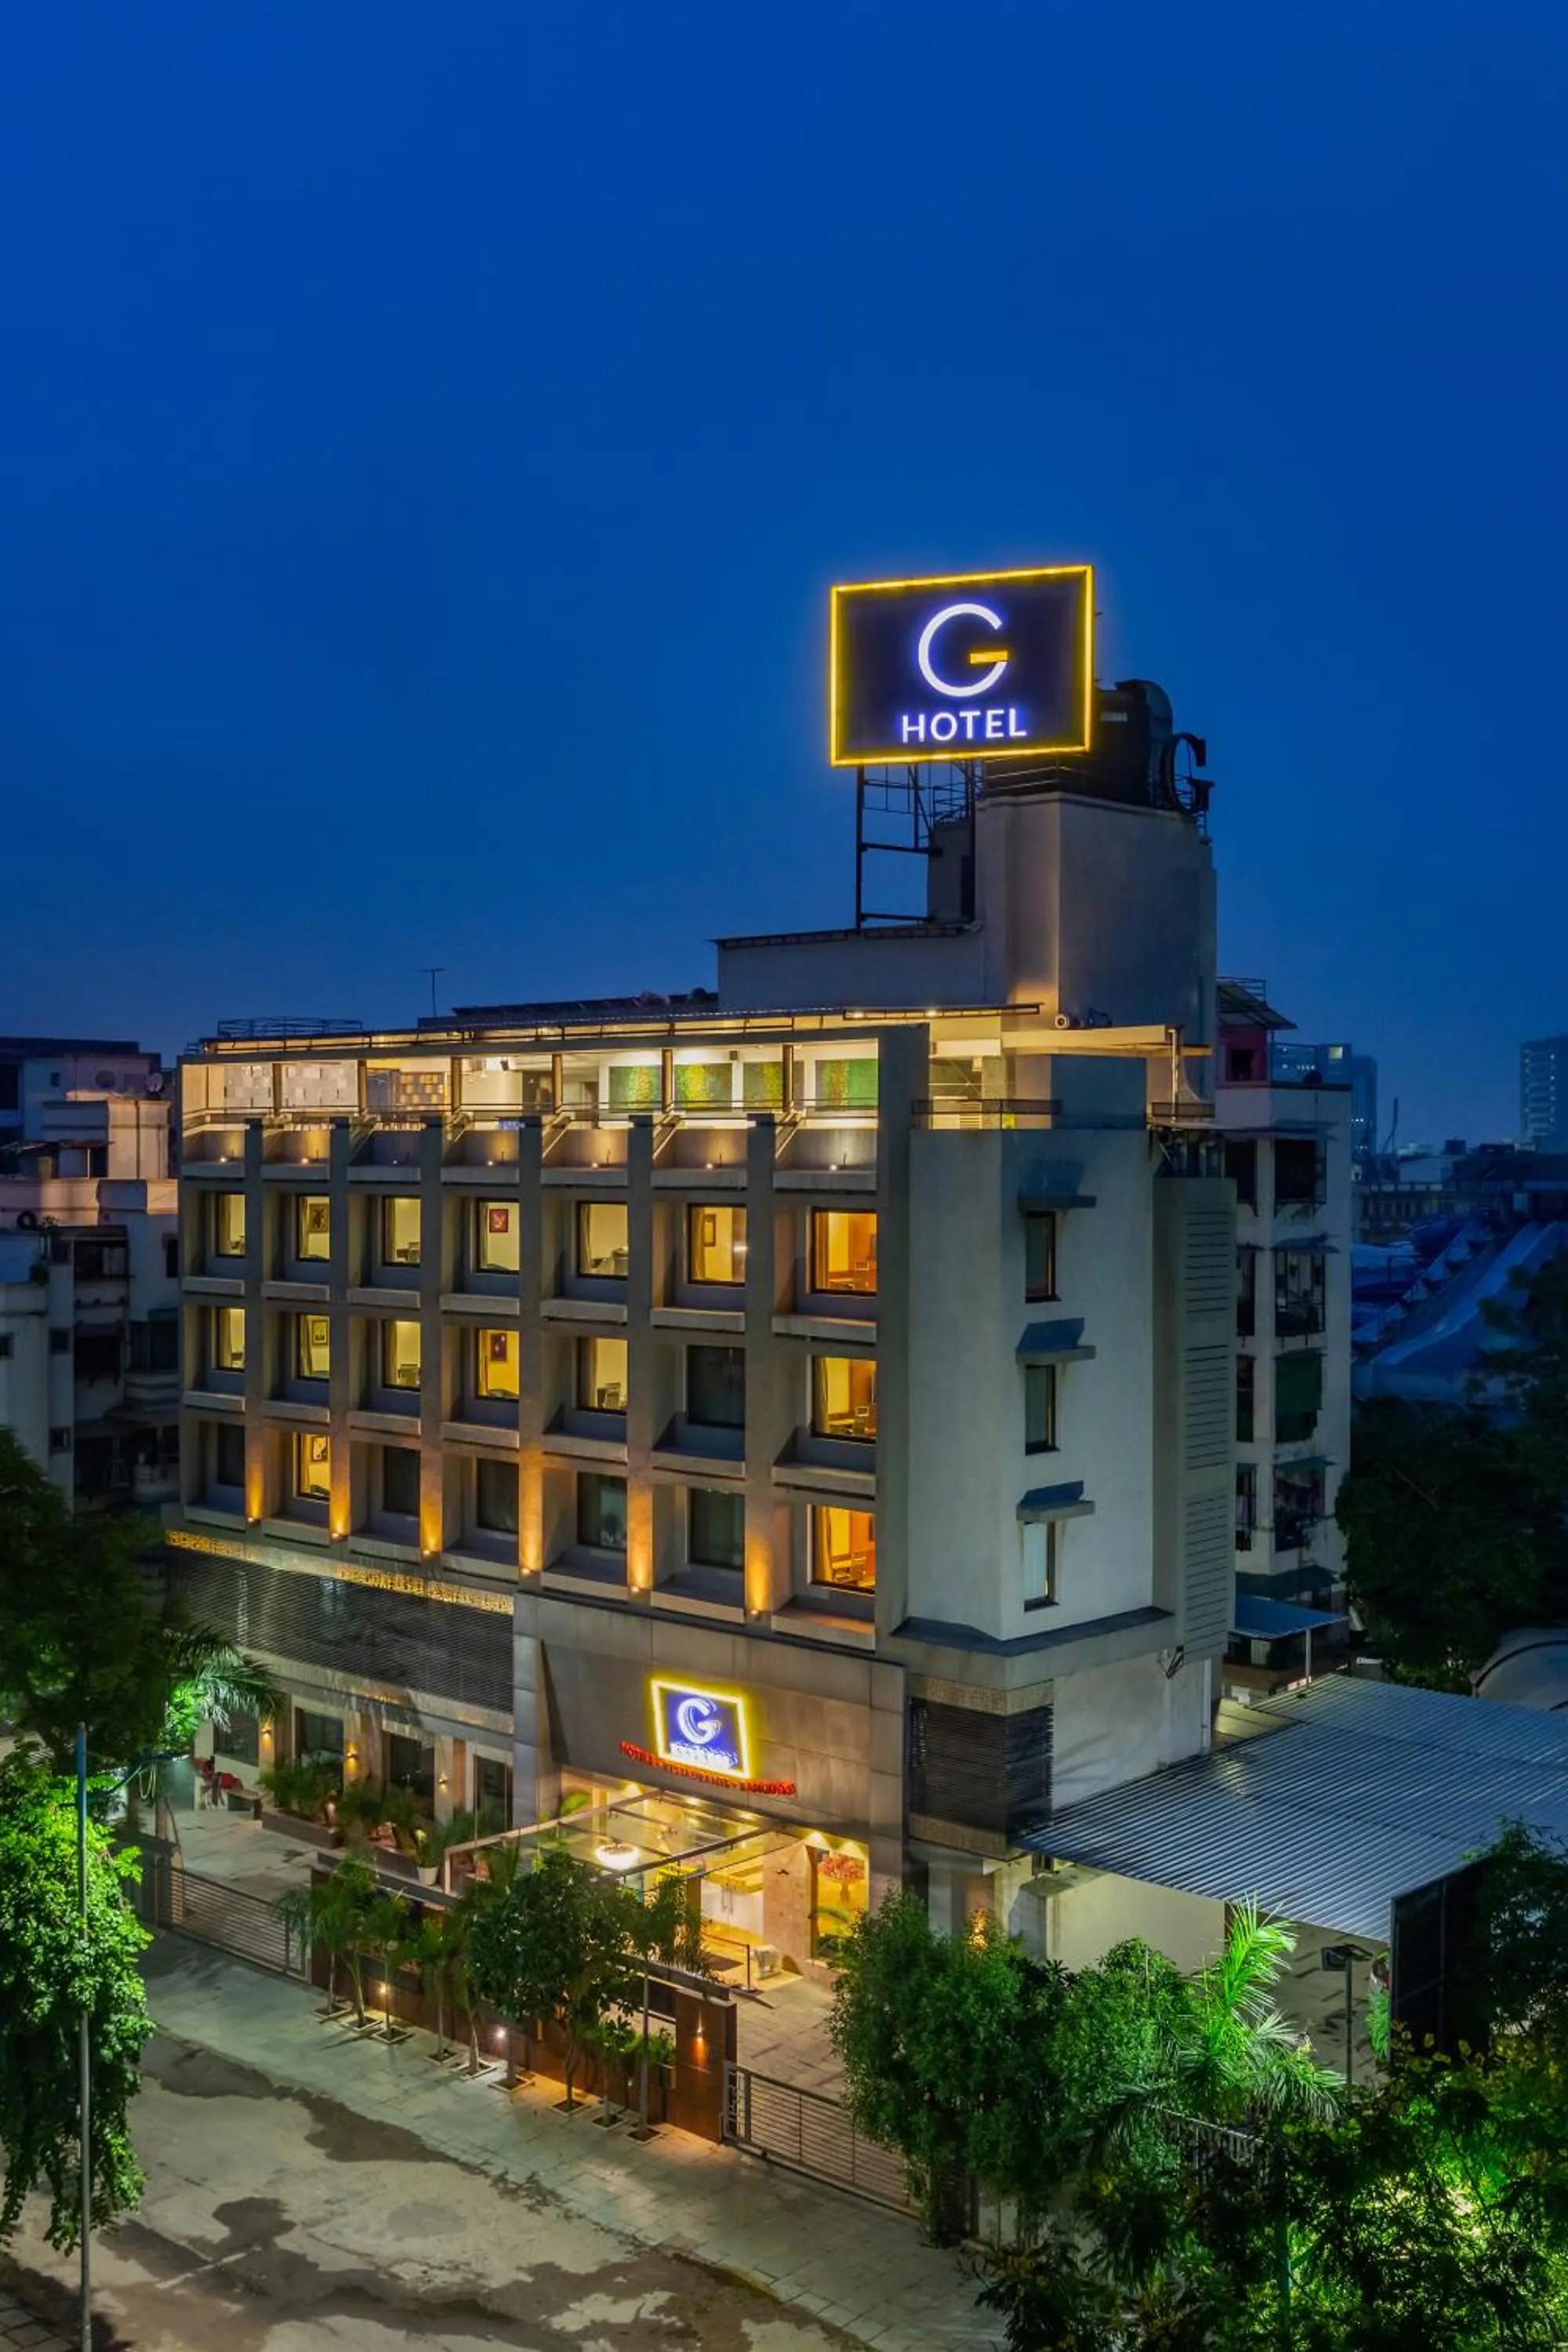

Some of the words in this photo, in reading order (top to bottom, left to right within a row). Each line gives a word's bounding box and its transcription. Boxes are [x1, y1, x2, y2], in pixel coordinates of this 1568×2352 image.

[918, 603, 1008, 697] G
[902, 708, 1027, 743] HOTEL
[1159, 732, 1215, 815] G
[677, 1697, 722, 1744] G
